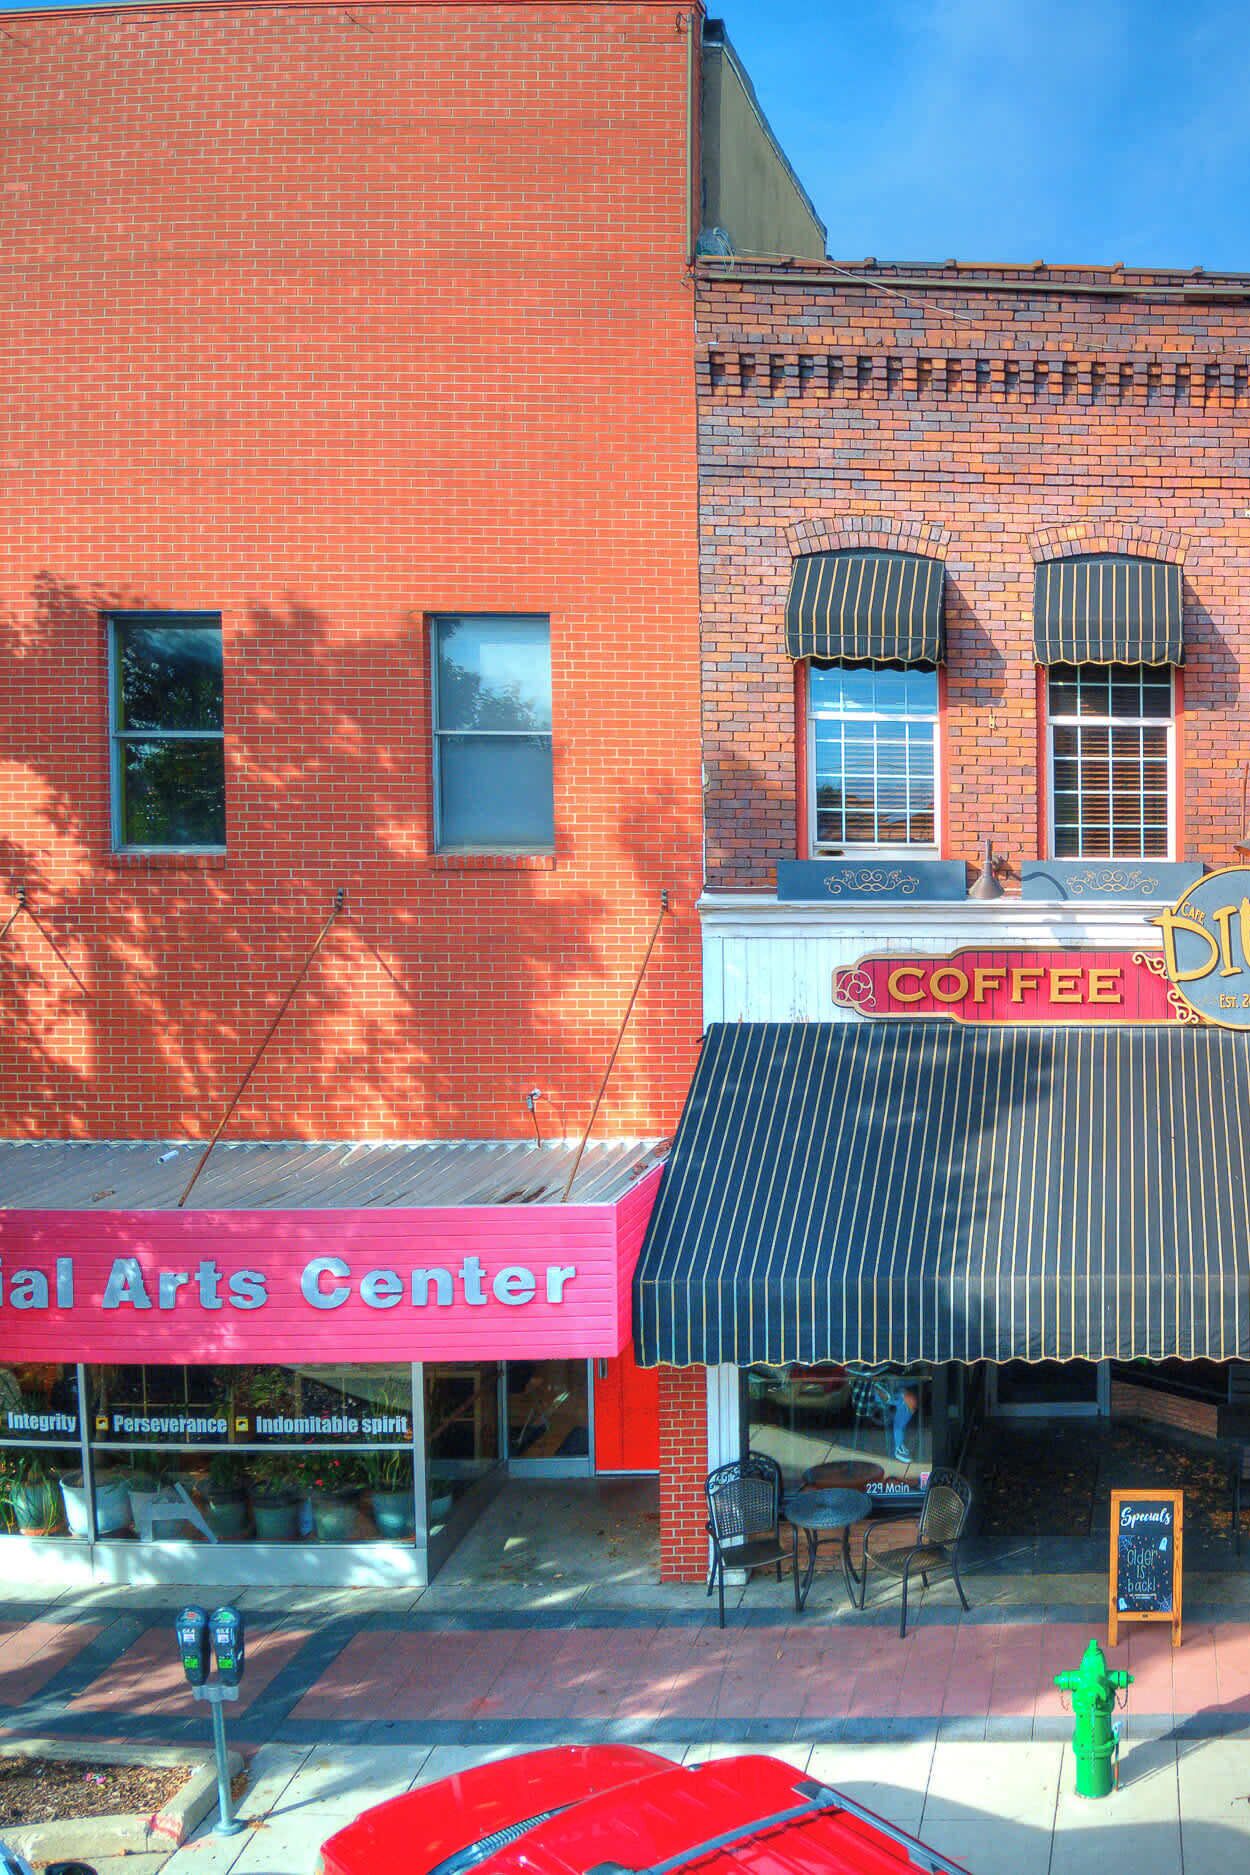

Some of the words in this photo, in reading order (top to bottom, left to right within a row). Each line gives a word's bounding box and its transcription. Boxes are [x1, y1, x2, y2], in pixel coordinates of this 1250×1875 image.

[887, 967, 1121, 1004] COFFEE
[0, 1257, 74, 1310] al
[102, 1257, 269, 1310] Arts
[301, 1255, 576, 1310] Center
[8, 1411, 77, 1433] Integrity
[113, 1415, 228, 1433] Perseverance
[256, 1415, 359, 1434] Indomitable
[361, 1415, 408, 1434] spirit
[866, 1483, 883, 1493] 229
[886, 1482, 910, 1493] Main
[1120, 1506, 1172, 1528] Specials
